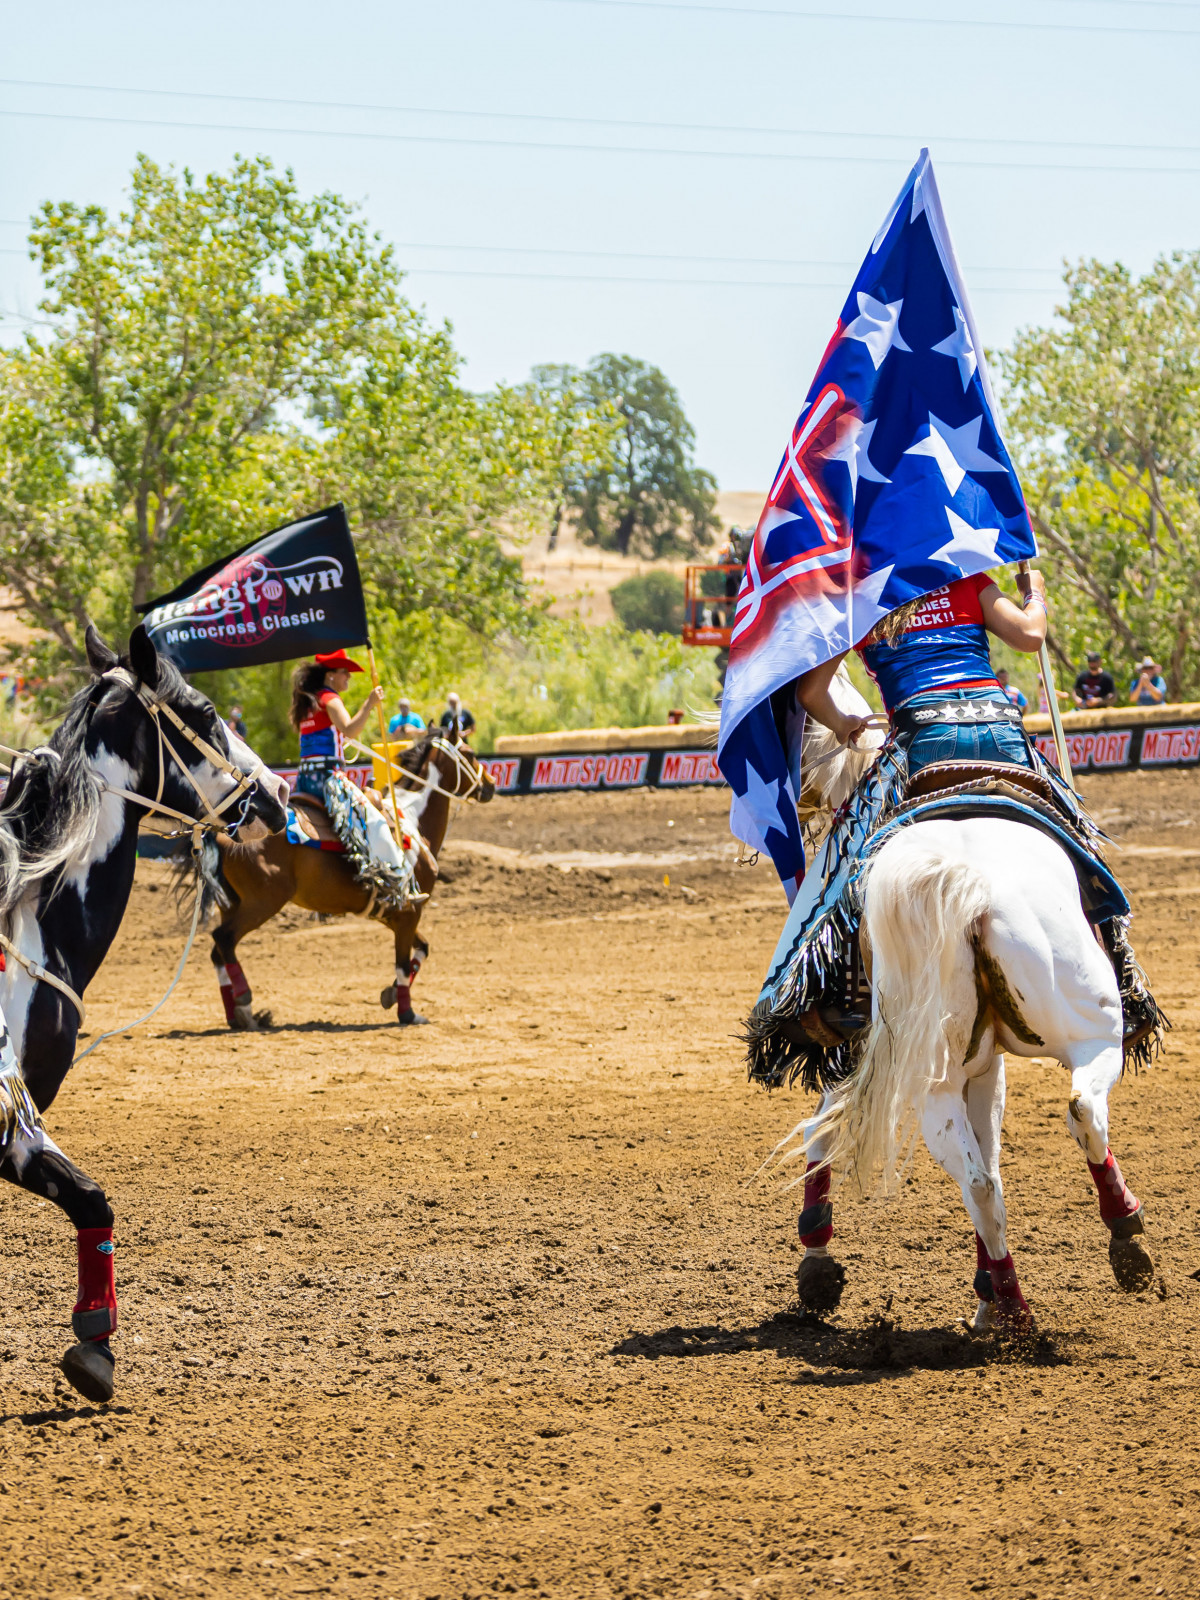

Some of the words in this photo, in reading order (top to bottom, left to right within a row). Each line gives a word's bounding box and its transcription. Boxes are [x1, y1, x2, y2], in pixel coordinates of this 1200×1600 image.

[166, 621, 257, 645] Motocross
[262, 607, 326, 631] Classic
[907, 611, 955, 628] OCK!!
